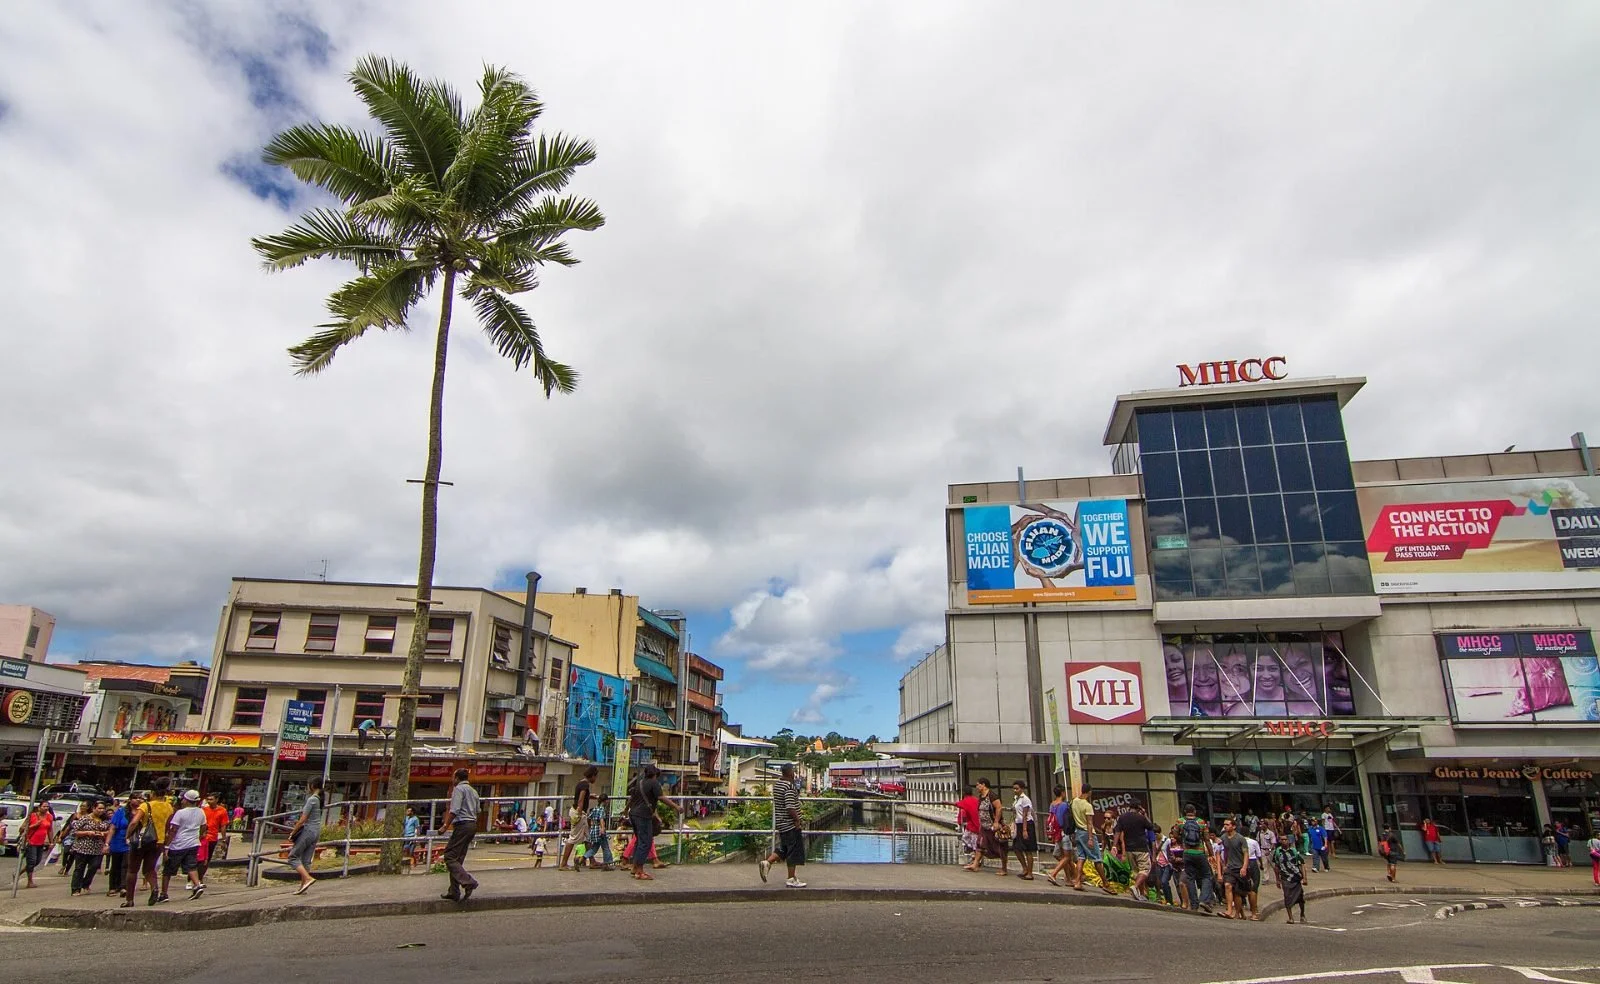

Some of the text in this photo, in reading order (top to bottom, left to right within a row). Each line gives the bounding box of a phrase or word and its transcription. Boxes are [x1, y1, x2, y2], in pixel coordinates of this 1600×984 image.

[1176, 356, 1288, 387] MHCC
[1082, 513, 1124, 522] TOGETHER
[1388, 507, 1492, 525] CONNECT TO
[967, 532, 1008, 542] CHOOSE
[1084, 522, 1127, 546] WE
[1391, 521, 1490, 537] THE ACTION
[1025, 526, 1060, 551] FIJIAN
[968, 543, 1009, 555] FIJIAN
[1041, 544, 1067, 564] MADE
[1087, 546, 1129, 555] SUPPORT
[968, 556, 1010, 569] MADE
[1088, 556, 1131, 579] FIJI
[1457, 636, 1502, 648] MHCC
[1533, 634, 1577, 646] MHCC
[1077, 679, 1135, 706] MH
[1264, 720, 1335, 737] MHCC
[1435, 767, 1593, 779] Gloria Jean's Coffees
[1092, 793, 1132, 812] space
